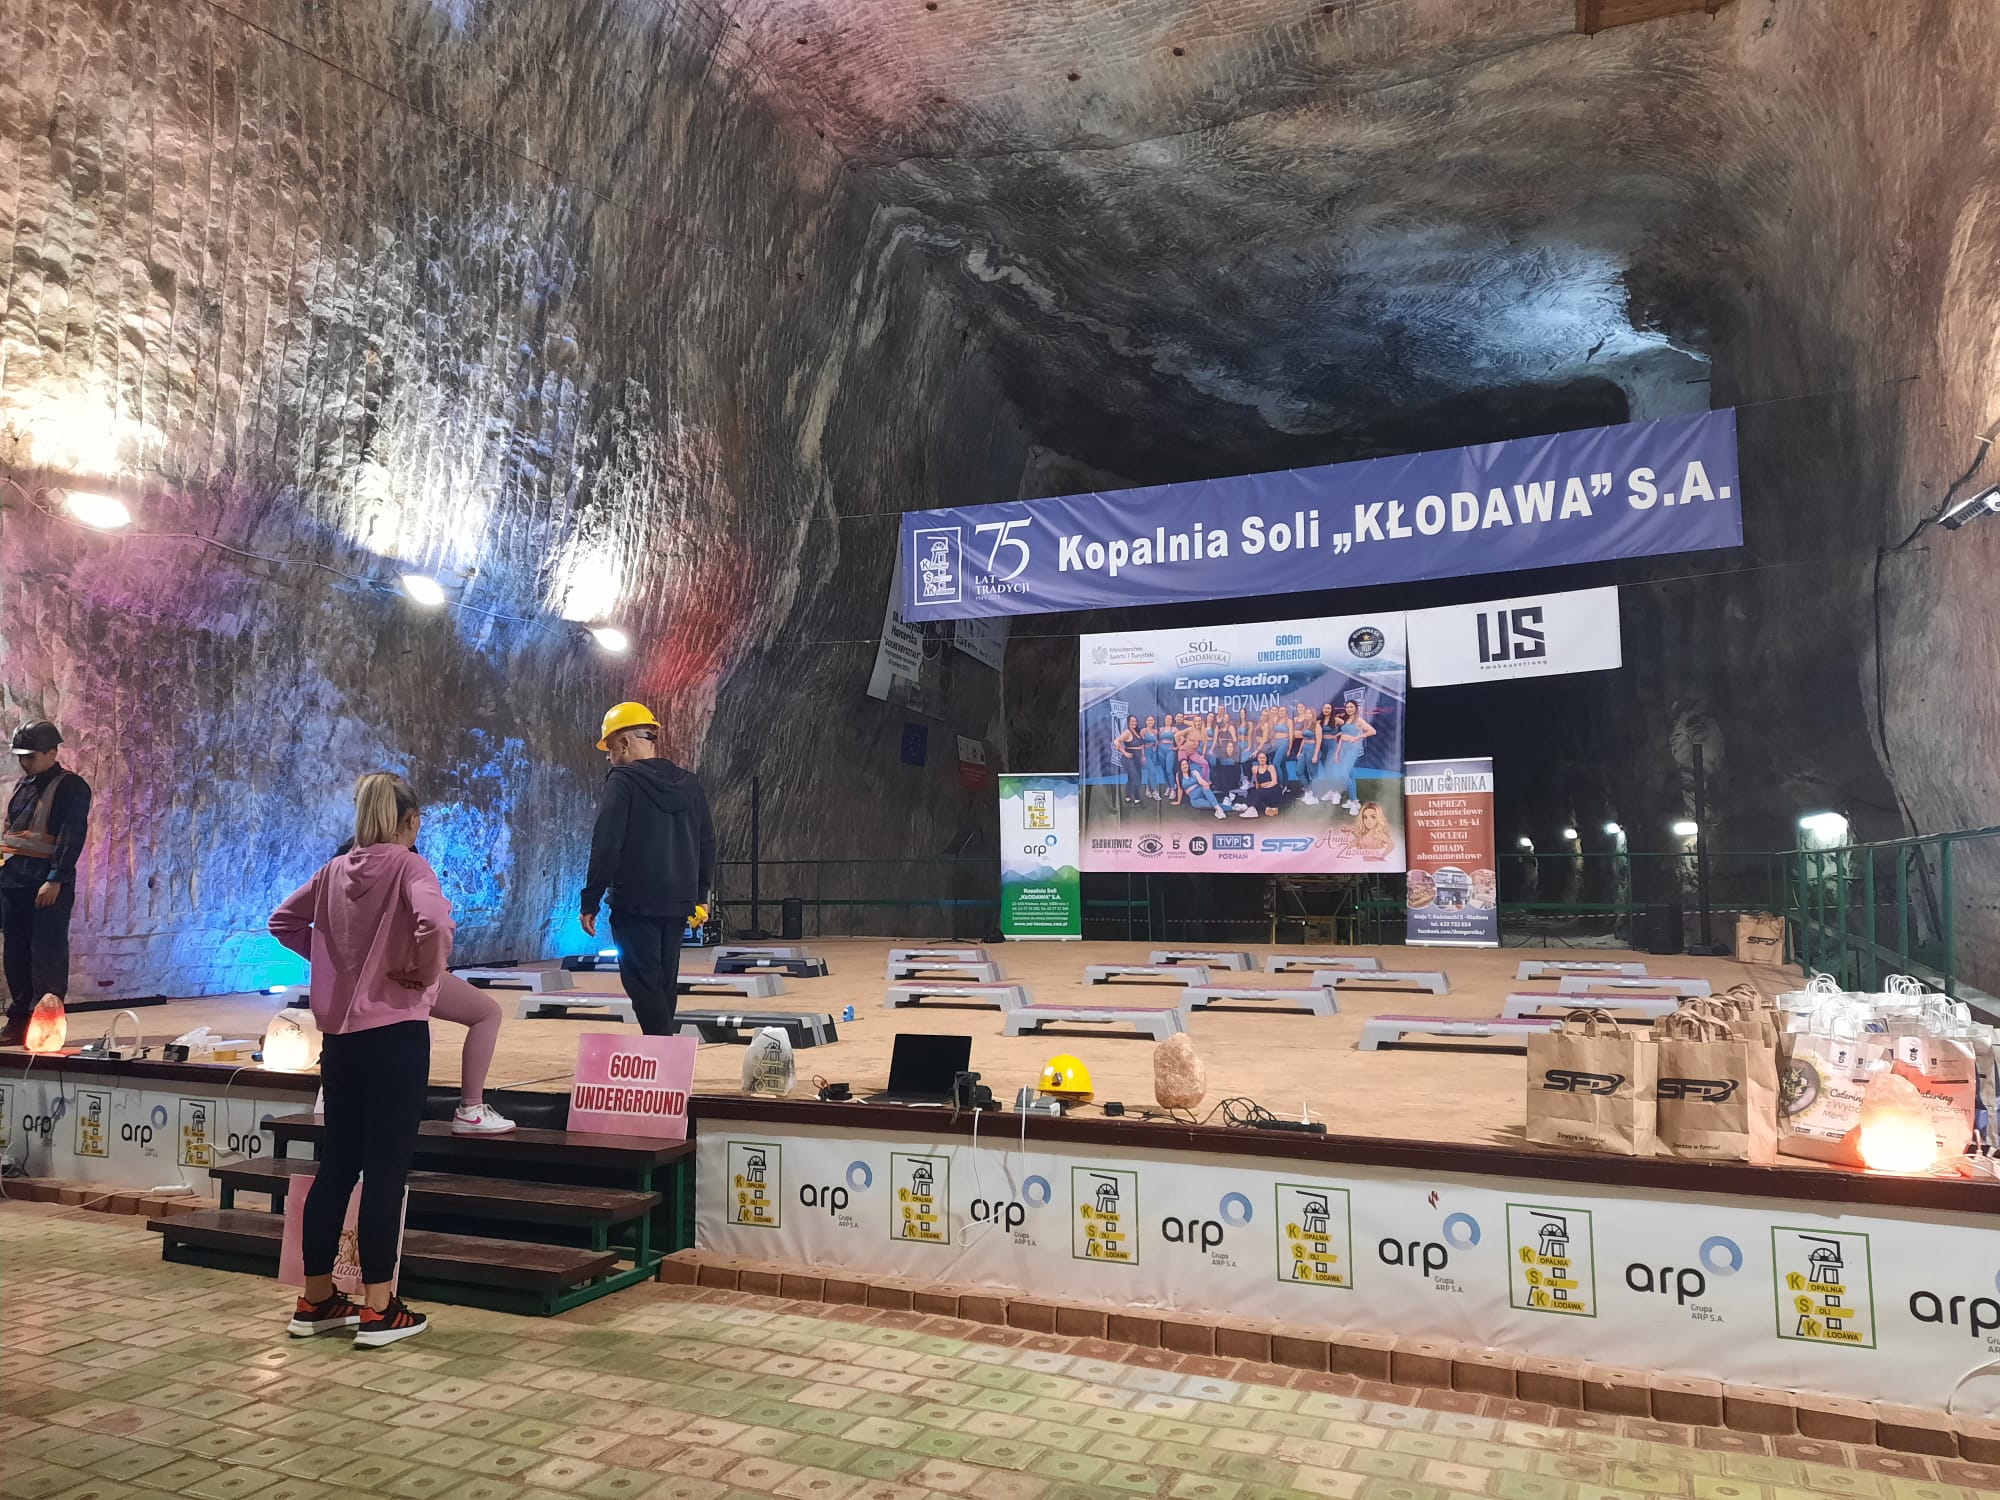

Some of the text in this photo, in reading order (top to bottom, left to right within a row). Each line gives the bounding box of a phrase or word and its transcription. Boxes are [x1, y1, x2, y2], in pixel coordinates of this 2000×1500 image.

[1058, 521, 1229, 577] Kopalnia
[1241, 509, 1320, 555] Soli
[1627, 459, 1731, 511] S.A.
[974, 516, 1033, 582] 75
[975, 574, 996, 585] LAT
[975, 582, 1030, 595] TRADYCJI
[1275, 635, 1303, 647] 600m
[1476, 606, 1546, 663] US
[1188, 638, 1218, 653] SÓL
[1257, 647, 1321, 662] UNDERGROUND
[1174, 672, 1289, 690] Enea Stadion
[1183, 690, 1280, 715] LECH POZNAŃ
[1410, 777, 1434, 793] DOM
[1428, 799, 1468, 809] IMPREZY
[1416, 818, 1453, 828] WESELA
[1429, 830, 1468, 840] NOCLEGI
[1023, 844, 1047, 857] arp
[1172, 840, 1181, 850] 5
[1191, 840, 1205, 852] US
[1260, 837, 1315, 852] SFD
[1432, 844, 1466, 853] OBIADY
[1416, 852, 1482, 861] abonamentowe
[610, 1053, 657, 1080] 600m
[1543, 1069, 1626, 1096] SFD
[1656, 1077, 1740, 1102] SFD
[574, 1085, 686, 1117] UNDERGROUND
[1829, 1088, 1865, 1107] Catering
[23, 1114, 52, 1139] arp
[121, 1122, 153, 1149] arp
[227, 1132, 262, 1159] arp
[799, 1183, 849, 1216] arp
[970, 1198, 1025, 1233] arp
[1161, 1216, 1224, 1253] arp
[1378, 1237, 1449, 1278] arp
[1625, 1262, 1706, 1306] arp
[1690, 1303, 1713, 1313] Grupa
[1691, 1312, 1708, 1320] ARP
[1909, 1290, 2000, 1338] arp
